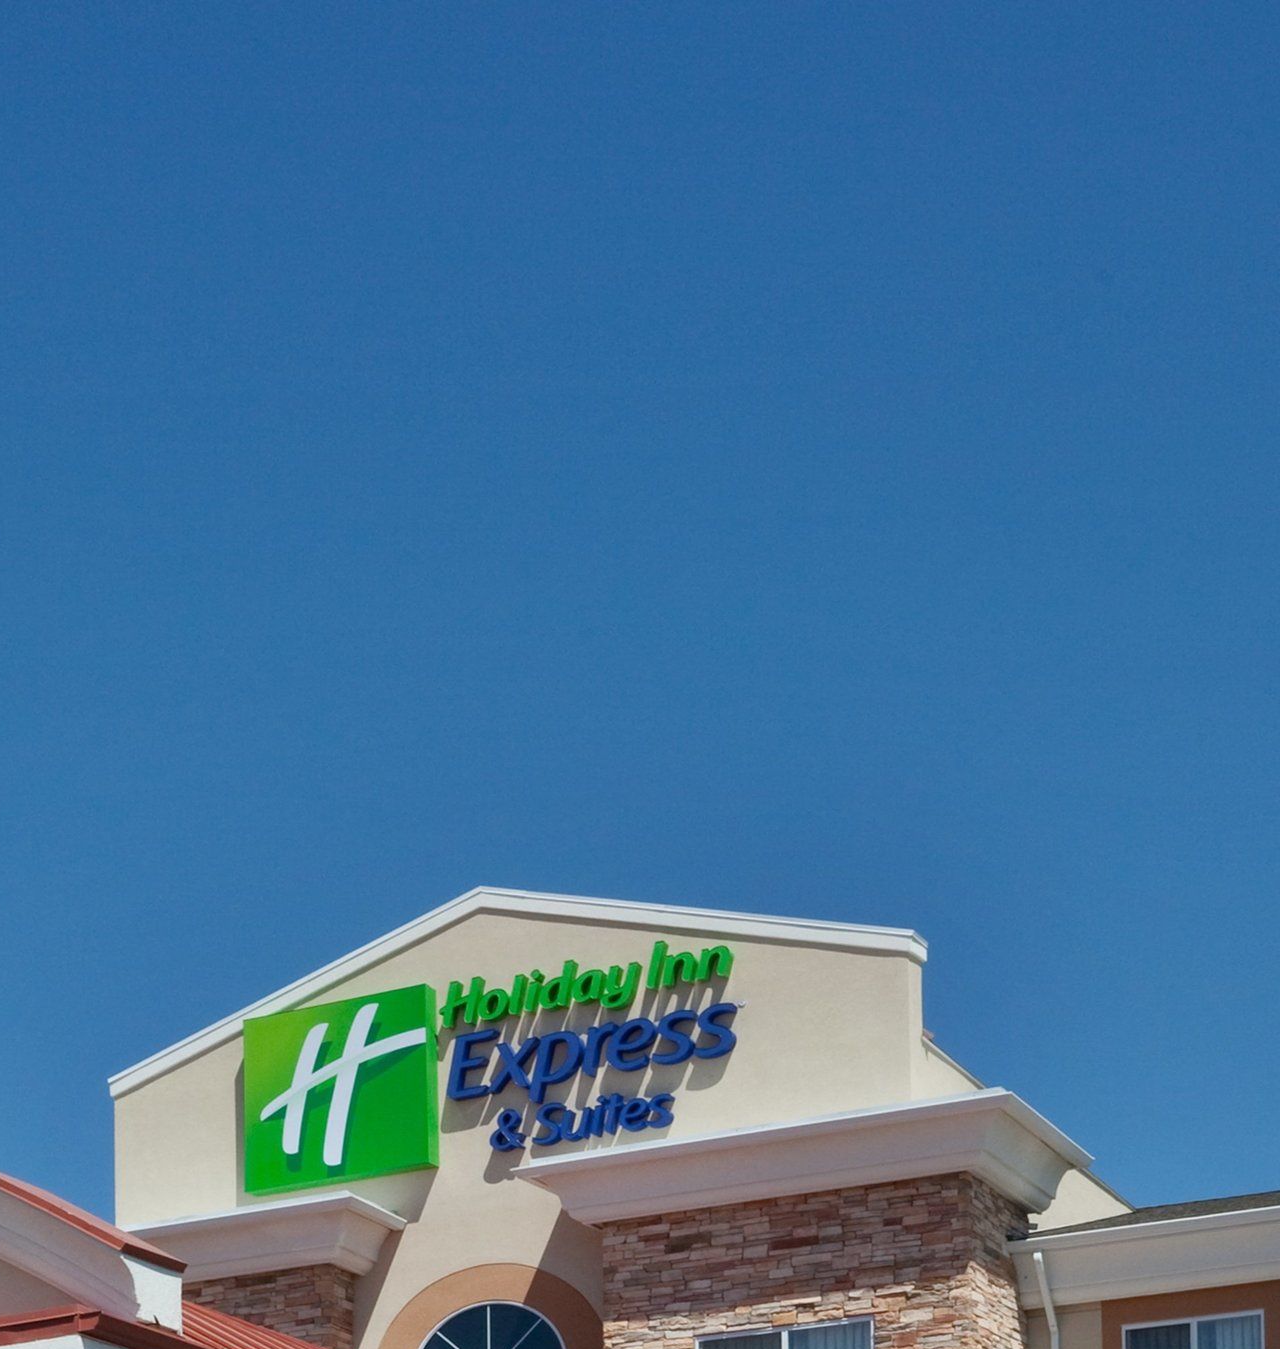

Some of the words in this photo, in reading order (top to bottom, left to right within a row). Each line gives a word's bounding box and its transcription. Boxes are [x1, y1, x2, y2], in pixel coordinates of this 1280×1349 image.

[440, 960, 642, 1028] Holiday
[646, 941, 734, 989] Inn
[447, 1002, 737, 1104] Express
[490, 1108, 526, 1150] &
[532, 1093, 675, 1146] Suites
